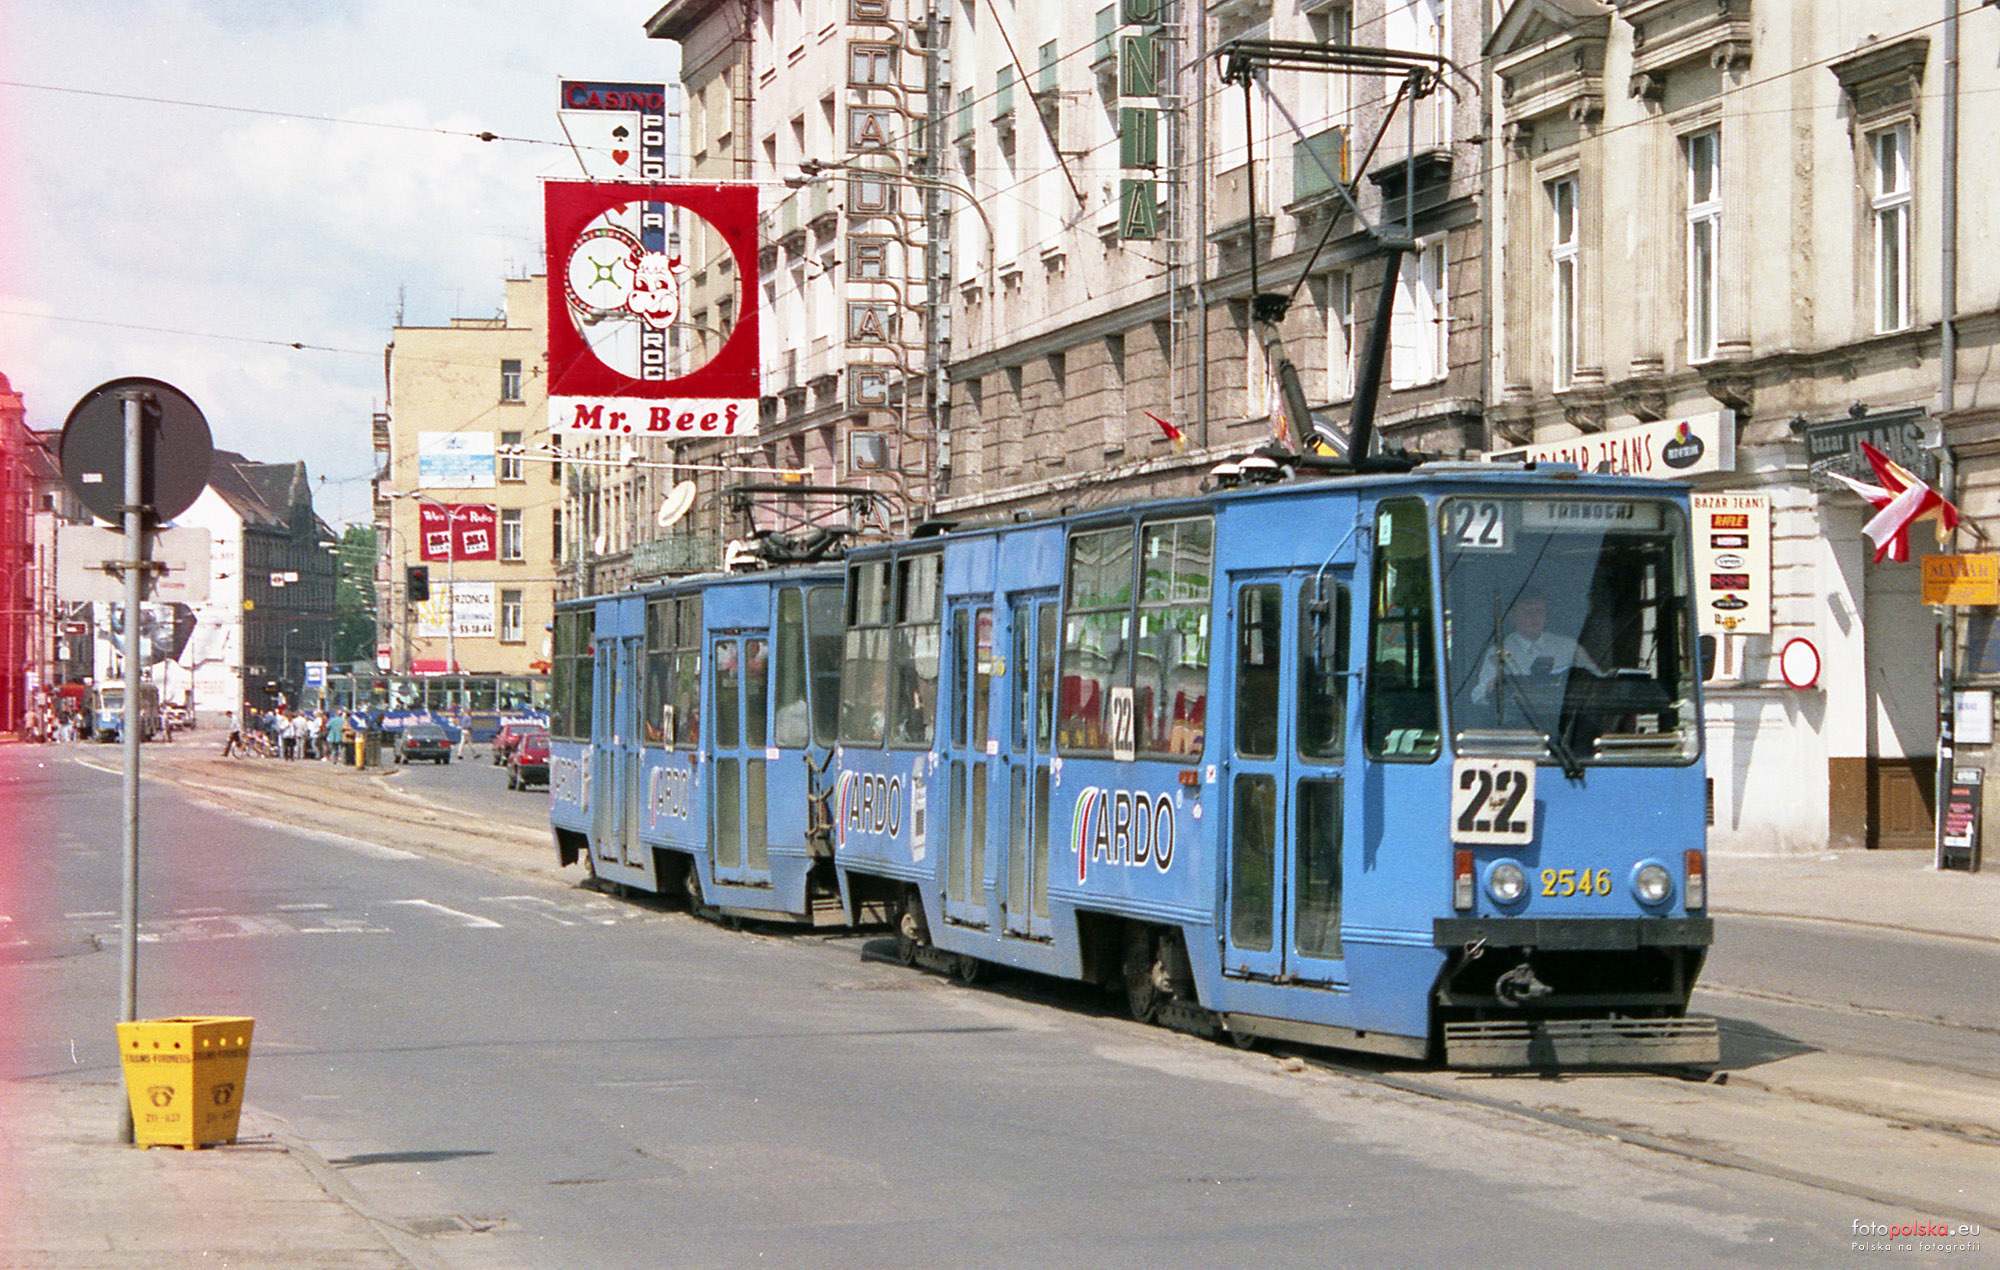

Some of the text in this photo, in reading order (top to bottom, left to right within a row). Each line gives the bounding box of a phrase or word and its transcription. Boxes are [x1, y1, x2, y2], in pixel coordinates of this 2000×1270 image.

[642, 114, 664, 228] POLOIA
[571, 403, 738, 435] Mr. Beef
[1600, 434, 1653, 476] JEANS
[1455, 501, 1499, 545] 22
[1694, 495, 1765, 509] BAZAR JEANS
[1714, 516, 1746, 528] RIFLE
[1113, 695, 1133, 752] 22
[656, 767, 690, 821] ARDO
[848, 771, 902, 839] ARDO
[1457, 769, 1528, 834] 22
[1093, 788, 1176, 875] ARDO
[1541, 868, 1612, 898] 2546
